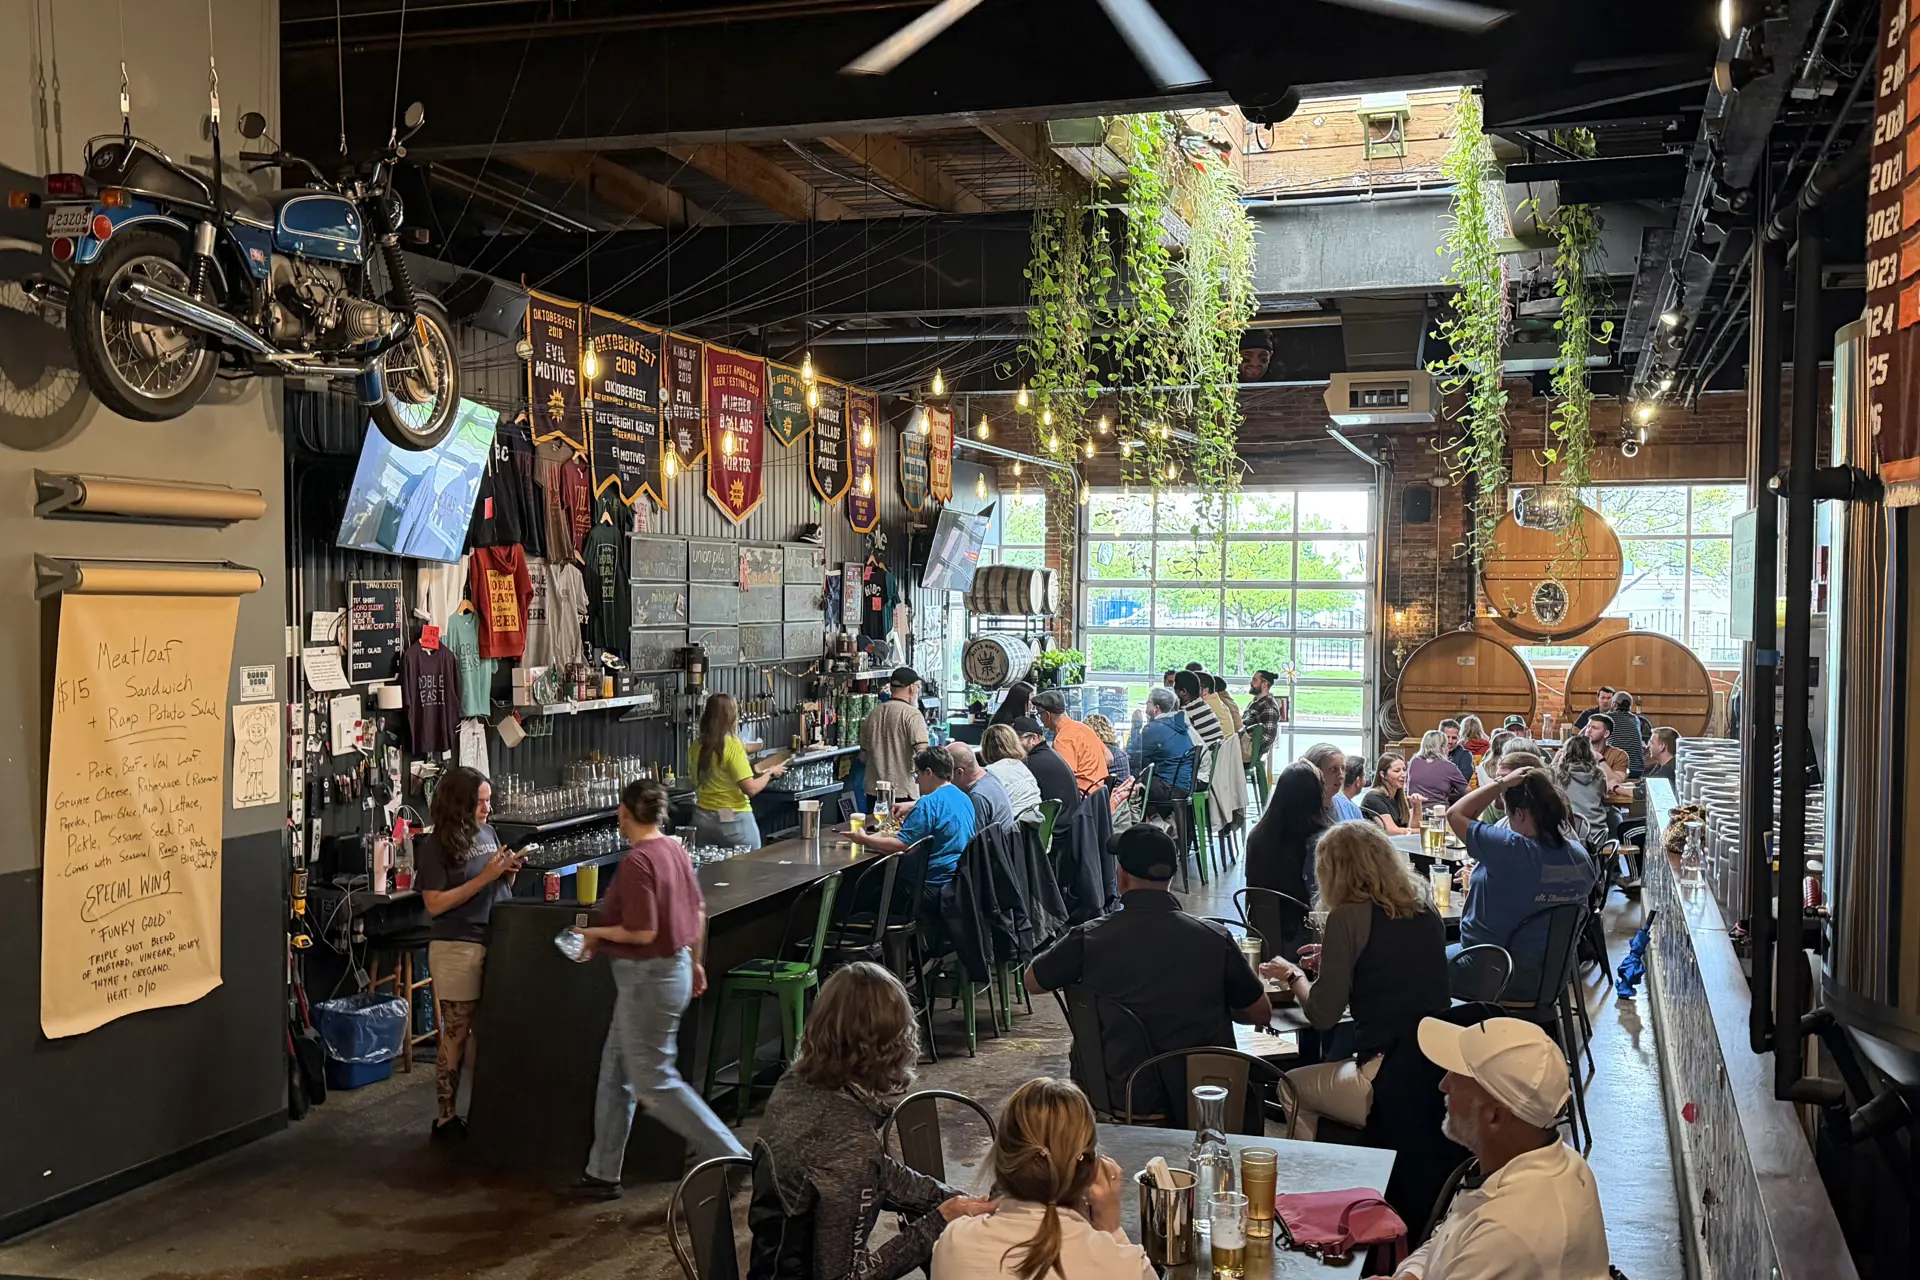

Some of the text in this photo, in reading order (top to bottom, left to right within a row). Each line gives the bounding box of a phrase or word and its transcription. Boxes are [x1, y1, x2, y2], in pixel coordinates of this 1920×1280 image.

[1869, 150, 1903, 195] 2021
[1867, 201, 1900, 246] 2022
[1866, 252, 1898, 291] 023
[533, 308, 576, 332] OKTOBERFEST
[1867, 303, 1895, 338] 024
[548, 325, 563, 340] 2018
[545, 342, 566, 364] EVIL
[594, 333, 657, 368] OKTOBERFEST
[673, 344, 697, 360] KING OF
[535, 360, 576, 386] MOTIVES
[615, 356, 637, 377] 2019
[677, 358, 692, 372] OHIO
[716, 364, 757, 384] GREAT AMERICAN
[1869, 353, 1890, 388] 25
[677, 372, 692, 384] 2019
[713, 377, 726, 388] BEER
[676, 388, 692, 405] EVIL
[721, 393, 752, 414] MURDER
[673, 404, 701, 420] OTIVES
[818, 406, 839, 424] MURDER
[817, 422, 841, 440] BALLADS
[819, 440, 837, 455] BALTIC
[620, 450, 646, 465] MOTIVES
[722, 455, 751, 474] PORTER
[817, 455, 838, 472] PORTER
[692, 546, 725, 569] union pils
[490, 580, 514, 591] OBLE
[491, 593, 515, 604] EAST
[493, 614, 517, 627] BEER
[527, 608, 546, 620] EER
[97, 636, 183, 671] Meatloaf
[353, 662, 372, 670] STICKER
[125, 673, 193, 698] Sandwich
[56, 677, 90, 714] $15
[419, 689, 445, 703] EAST
[88, 698, 220, 731] + Ramp Potato Salad
[152, 753, 168, 769] Veal
[108, 826, 143, 846] Sesame
[151, 823, 173, 839] Seed
[178, 818, 195, 835] Bun
[64, 861, 89, 878] Comes
[94, 854, 112, 870] with
[119, 846, 151, 863] Seasonal
[86, 877, 133, 913] SPECIAL
[88, 932, 176, 967] TRIPLE SHOT BLEND
[82, 969, 92, 981] OF
[96, 958, 134, 975] MUSTARD,
[139, 947, 176, 964] VINEGAR,
[91, 975, 119, 992] THYME
[107, 986, 132, 1004] HEAT:
